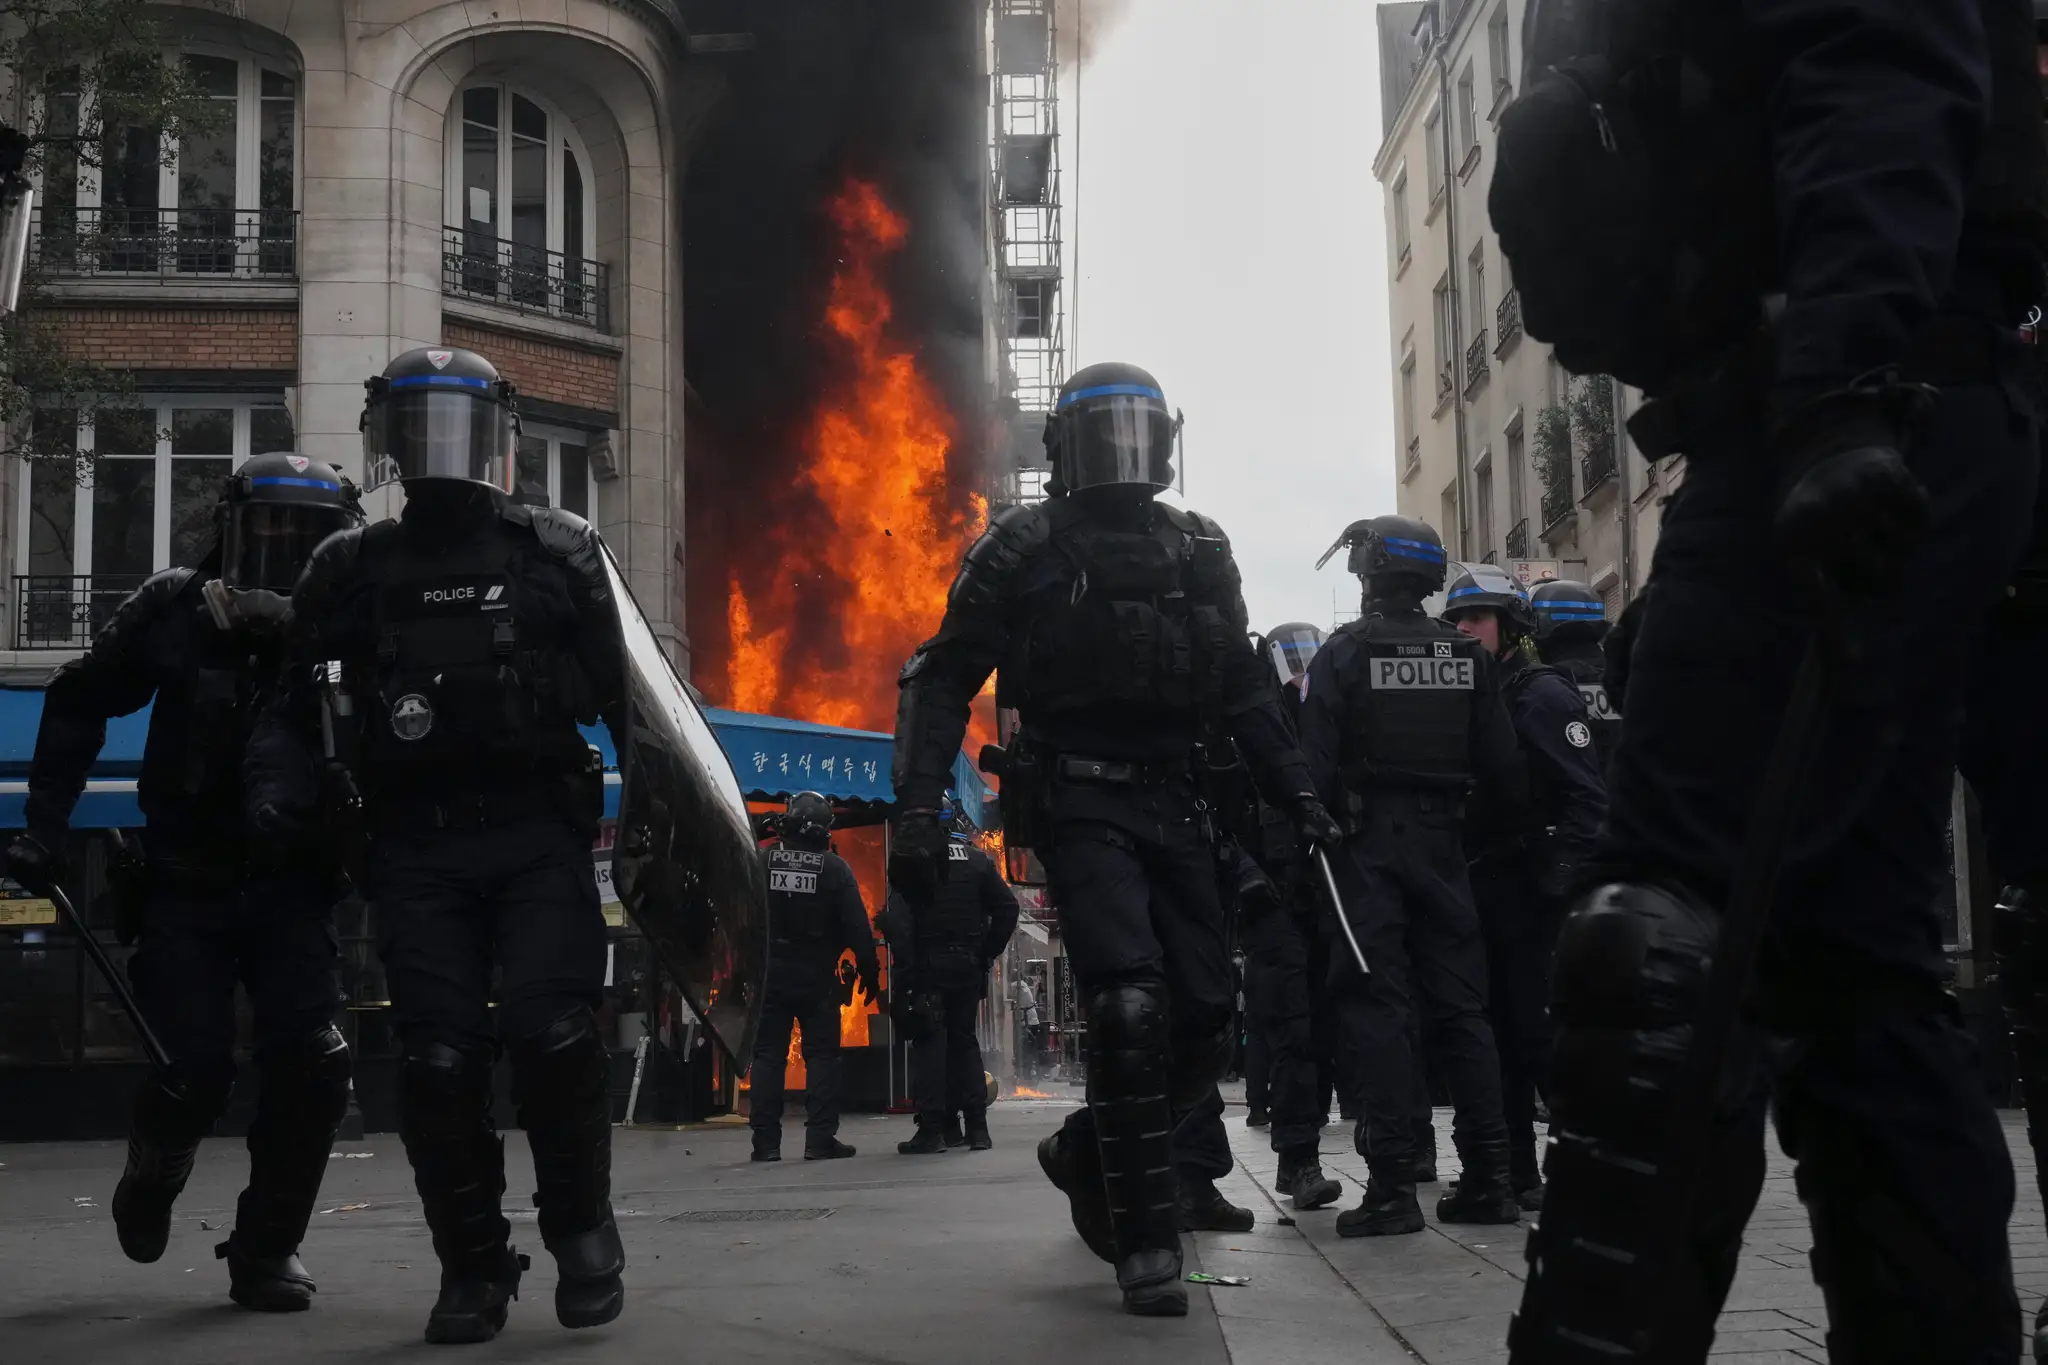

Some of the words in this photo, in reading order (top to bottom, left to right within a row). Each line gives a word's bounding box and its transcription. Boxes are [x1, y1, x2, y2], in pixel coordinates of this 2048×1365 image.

[424, 586, 476, 603] POLICE
[1380, 661, 1470, 686] POLICE
[1580, 690, 1622, 715] PO
[772, 851, 821, 866] POLICE
[772, 873, 788, 888] TX
[794, 875, 816, 890] 311
[1063, 957, 1071, 1019] SANDWICHES
